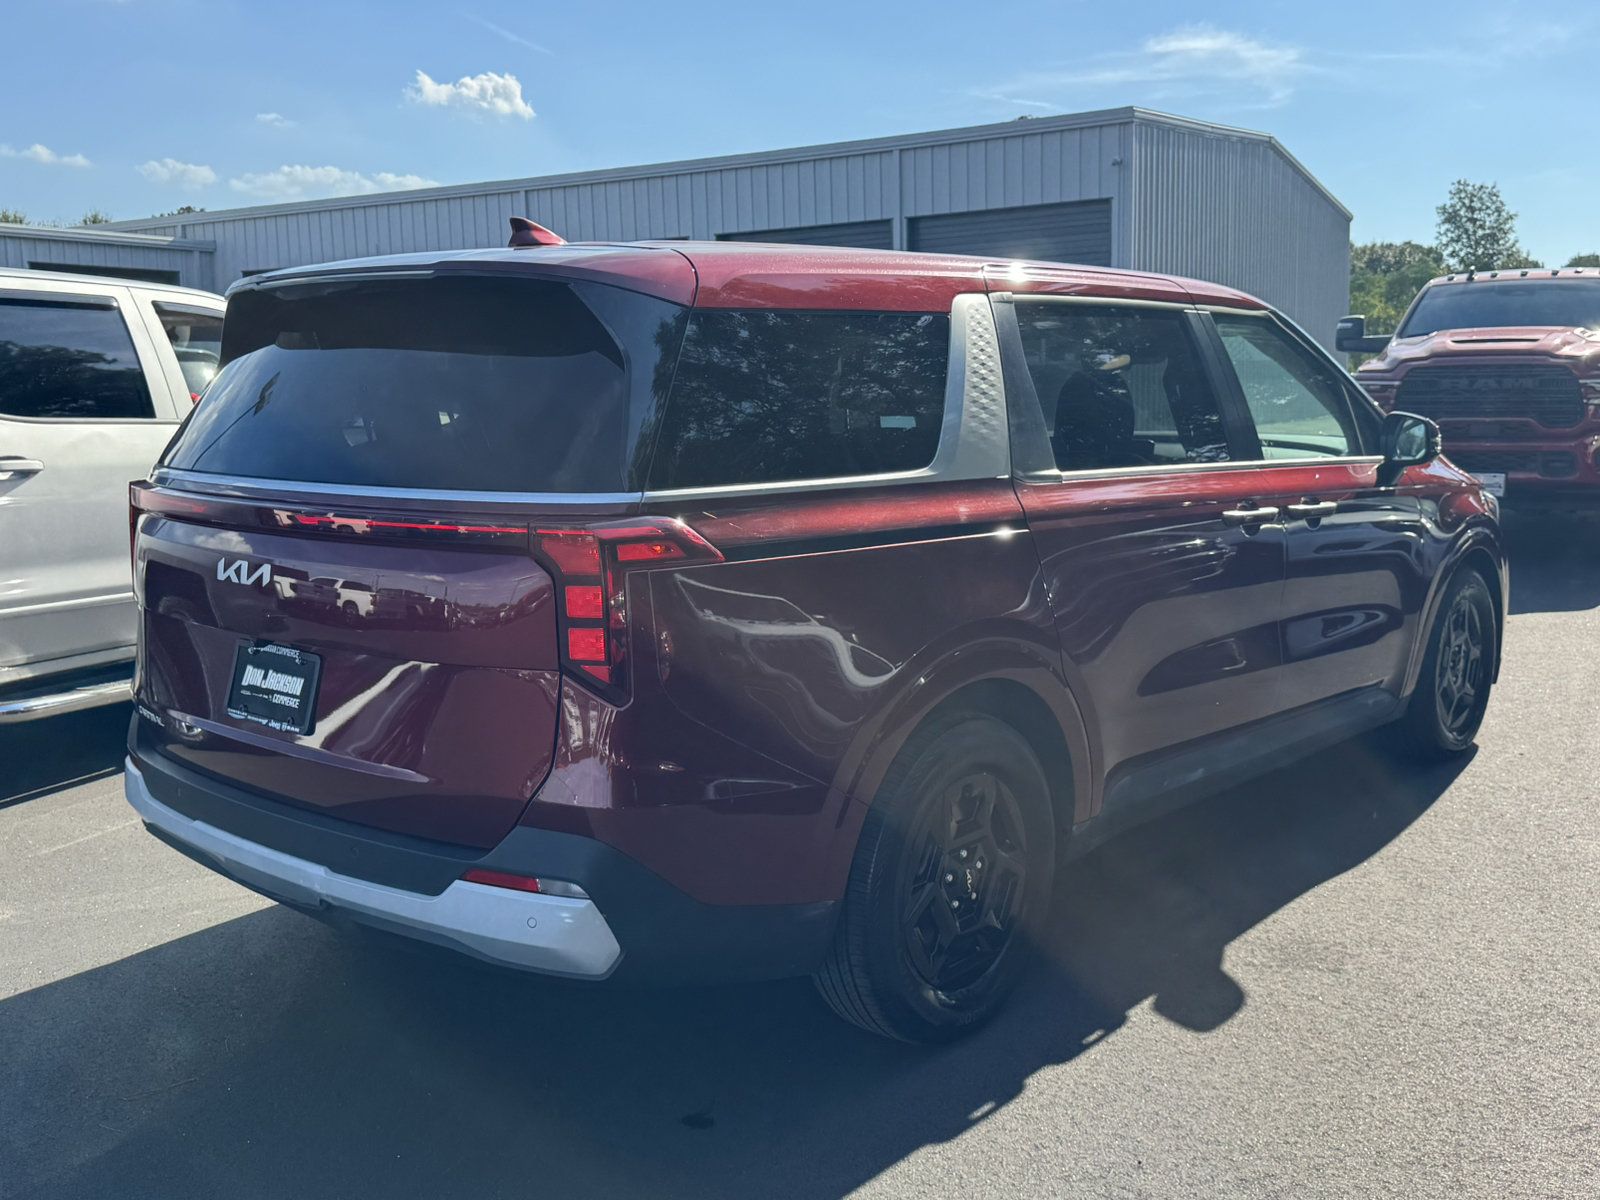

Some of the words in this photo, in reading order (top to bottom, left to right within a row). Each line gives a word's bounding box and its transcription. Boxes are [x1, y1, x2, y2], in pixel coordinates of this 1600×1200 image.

[217, 557, 271, 587] KIA
[261, 669, 304, 696] JACKSON
[272, 694, 299, 708] COMMERCE
